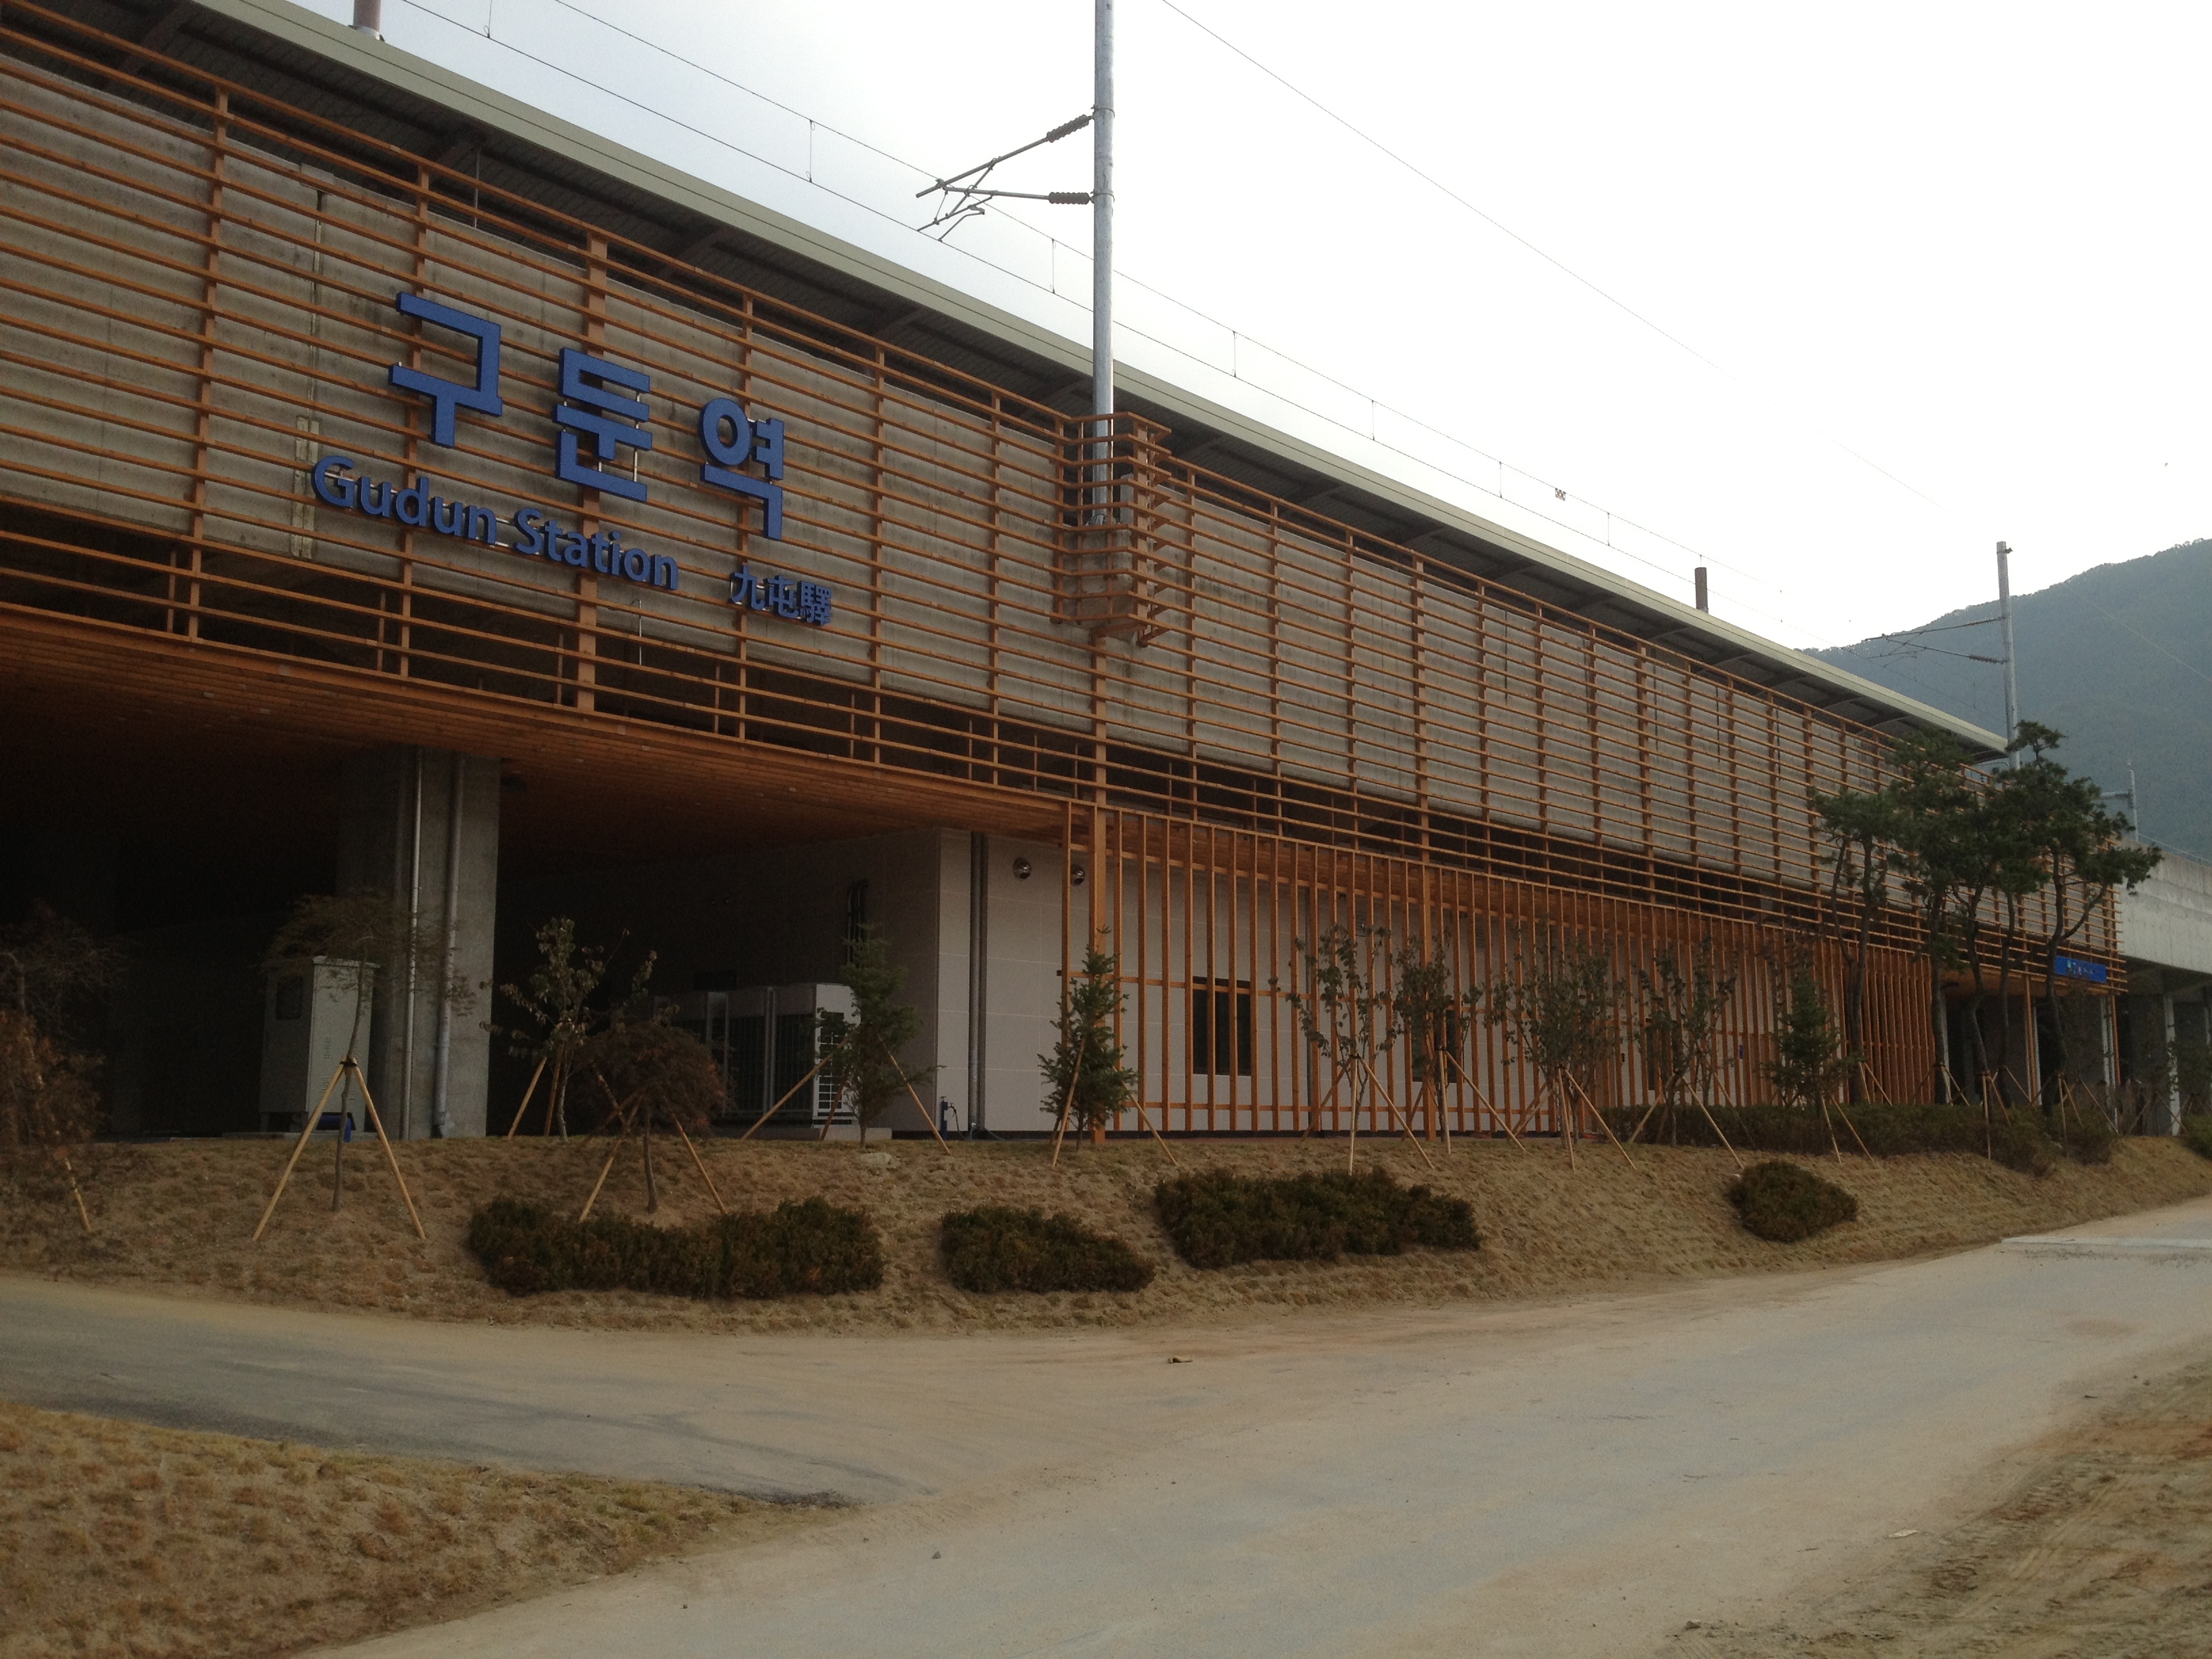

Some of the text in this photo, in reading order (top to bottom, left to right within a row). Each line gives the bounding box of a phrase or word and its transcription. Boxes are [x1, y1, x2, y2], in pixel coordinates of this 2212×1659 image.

[388, 292, 784, 540] 구둔역
[312, 455, 678, 590] Gudun Station
[729, 565, 832, 626] 九屯驛
